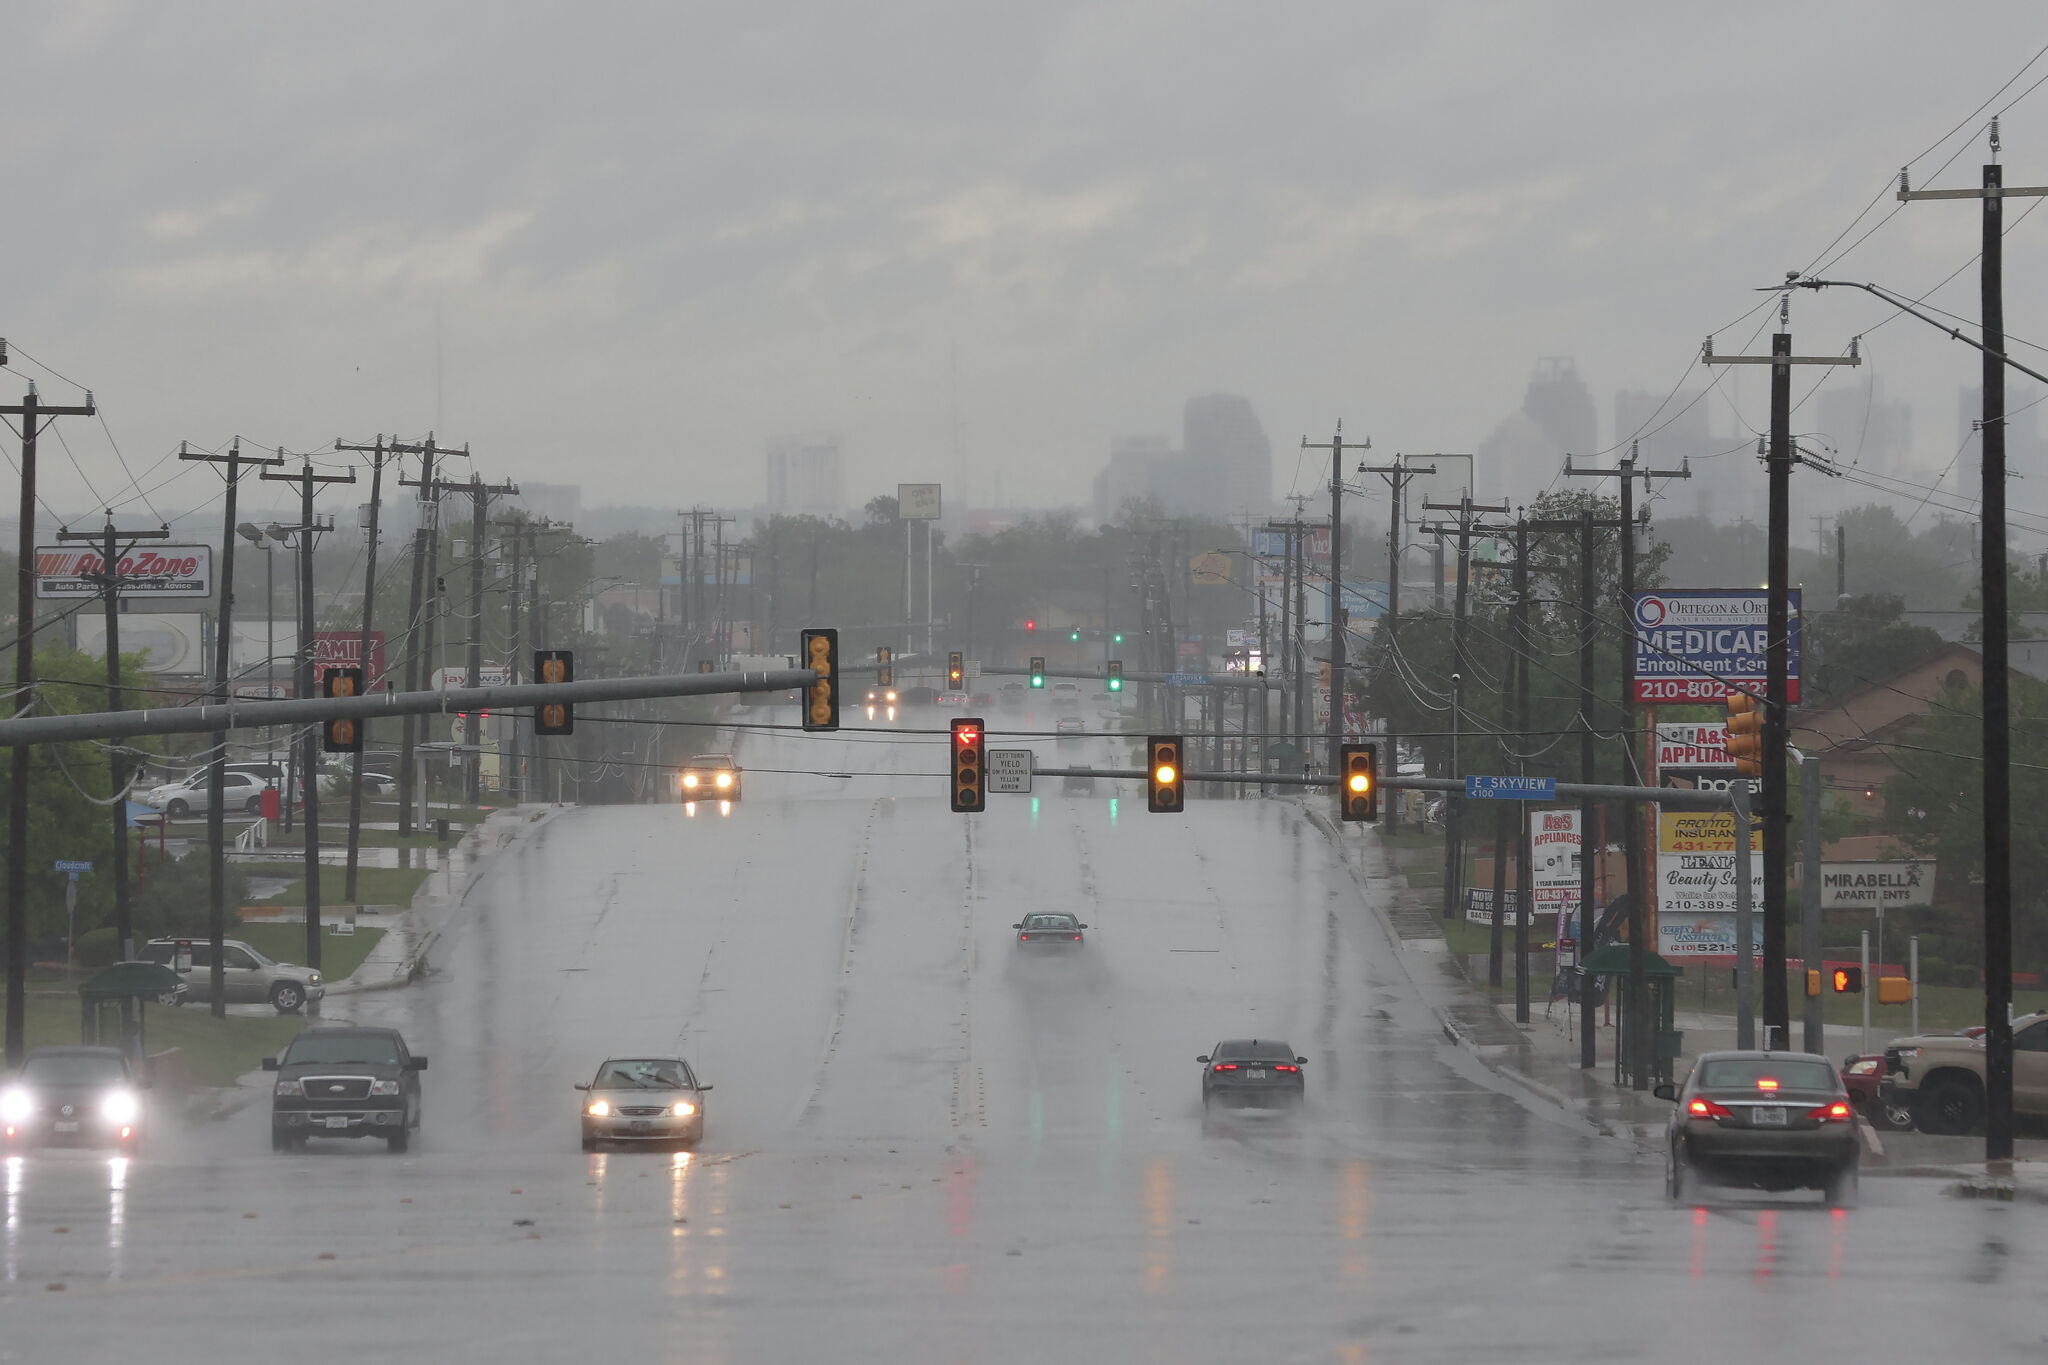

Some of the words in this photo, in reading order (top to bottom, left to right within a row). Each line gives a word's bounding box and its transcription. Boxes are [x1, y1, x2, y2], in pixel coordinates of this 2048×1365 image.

[72, 553, 198, 577] AuoZone
[1730, 603, 1740, 614] &
[1475, 777, 1482, 788] E
[1491, 777, 1546, 790] SKYVIEW
[1667, 870, 1718, 892] Beauty
[1824, 873, 1920, 887] MIRABELLA
[1670, 944, 1696, 952] (210)
